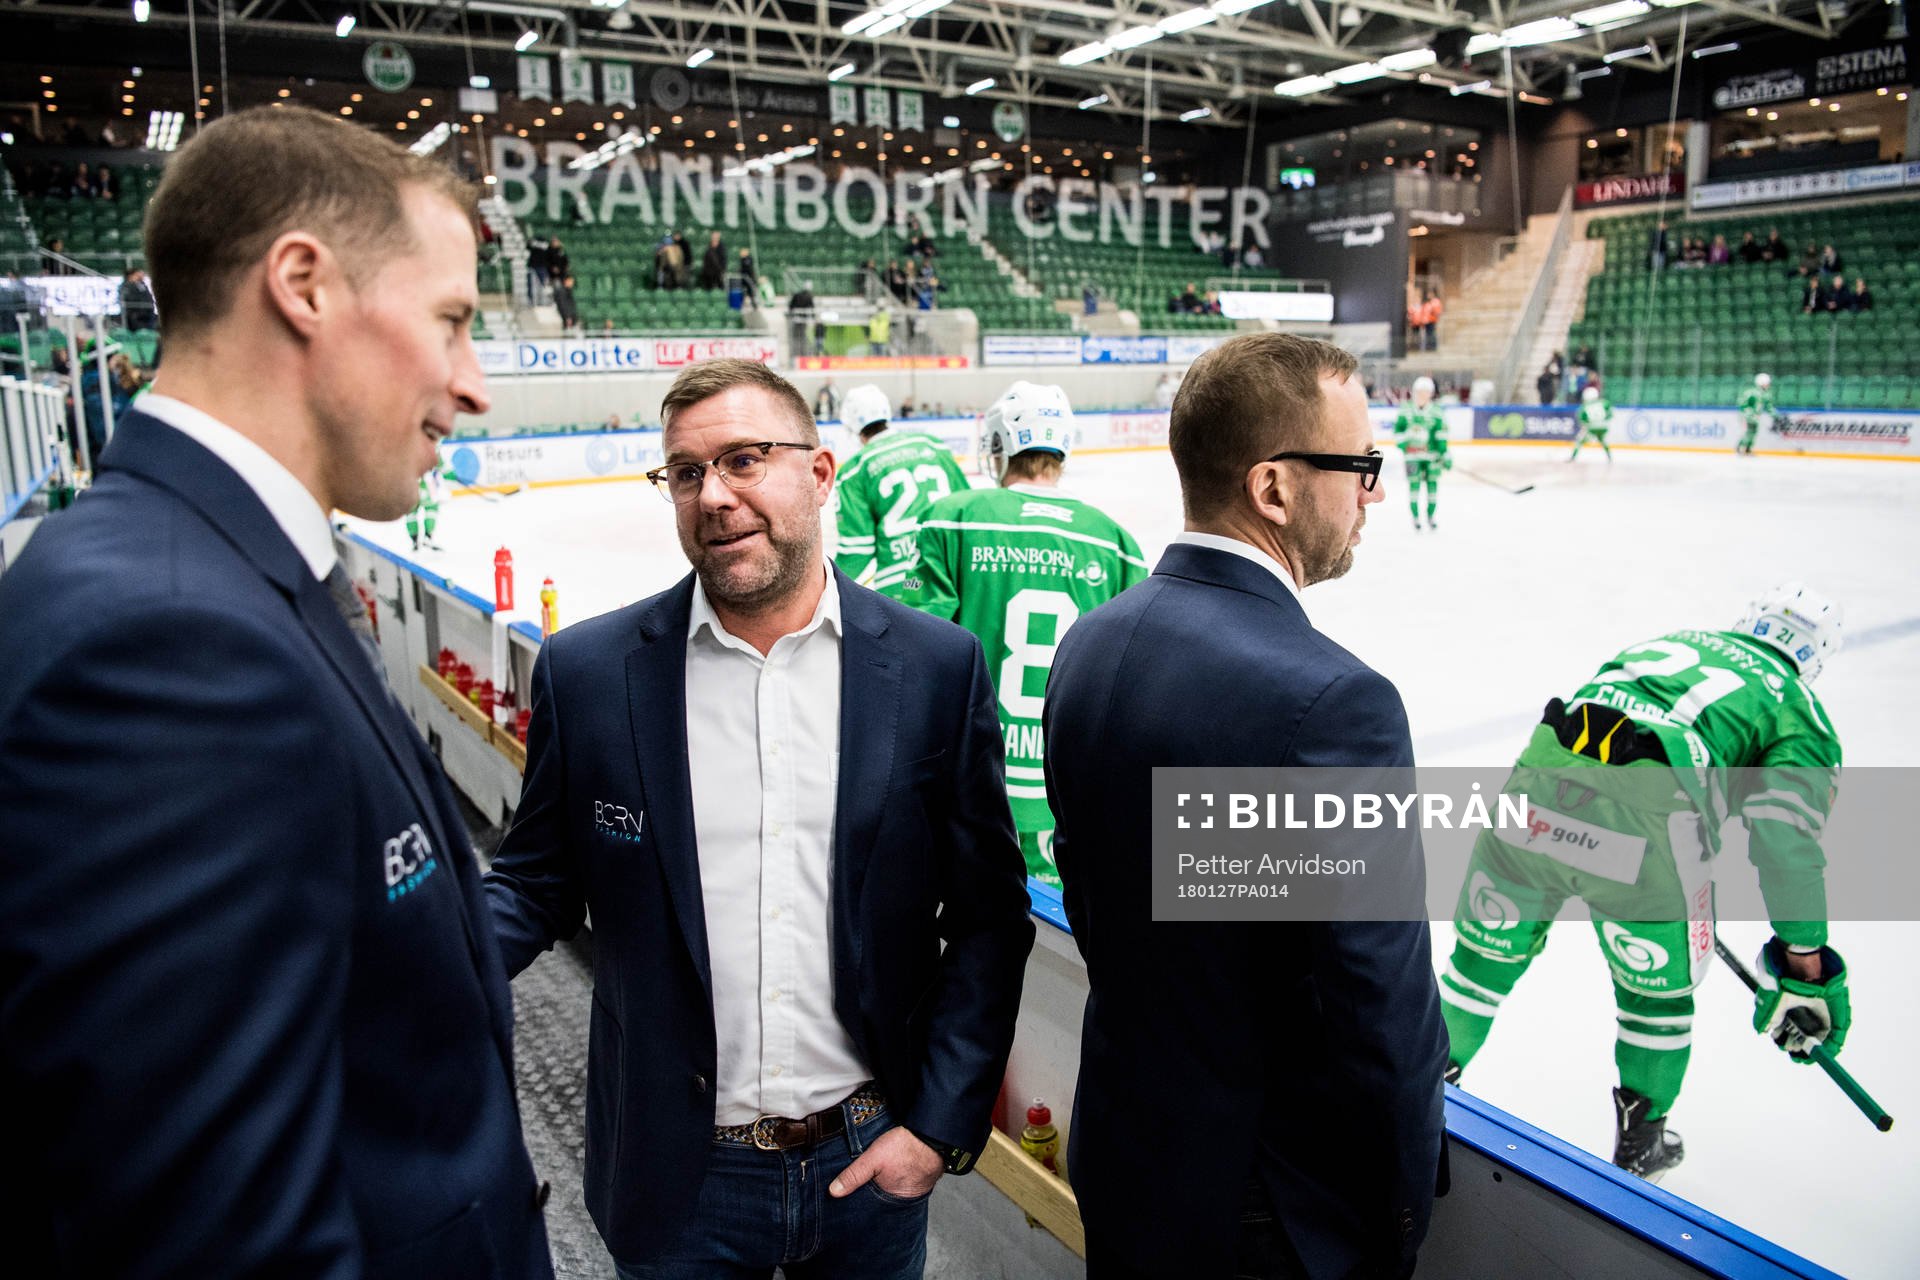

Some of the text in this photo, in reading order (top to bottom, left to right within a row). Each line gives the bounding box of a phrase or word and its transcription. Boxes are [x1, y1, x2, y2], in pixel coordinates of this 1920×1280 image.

[1839, 45, 1906, 74] STENA
[1816, 67, 1906, 93] RECYCLING
[1012, 174, 1271, 250] CENTER
[519, 343, 640, 368] Deloitte
[1659, 419, 1726, 439] Lindab
[486, 446, 543, 461] Resurs
[972, 545, 1075, 570] BRÄNNBORN
[1776, 627, 1795, 645] 21
[998, 588, 1079, 719] 8
[1551, 826, 1600, 850] golv
[1484, 932, 1512, 950] kraft
[1636, 975, 1668, 987] kraft
